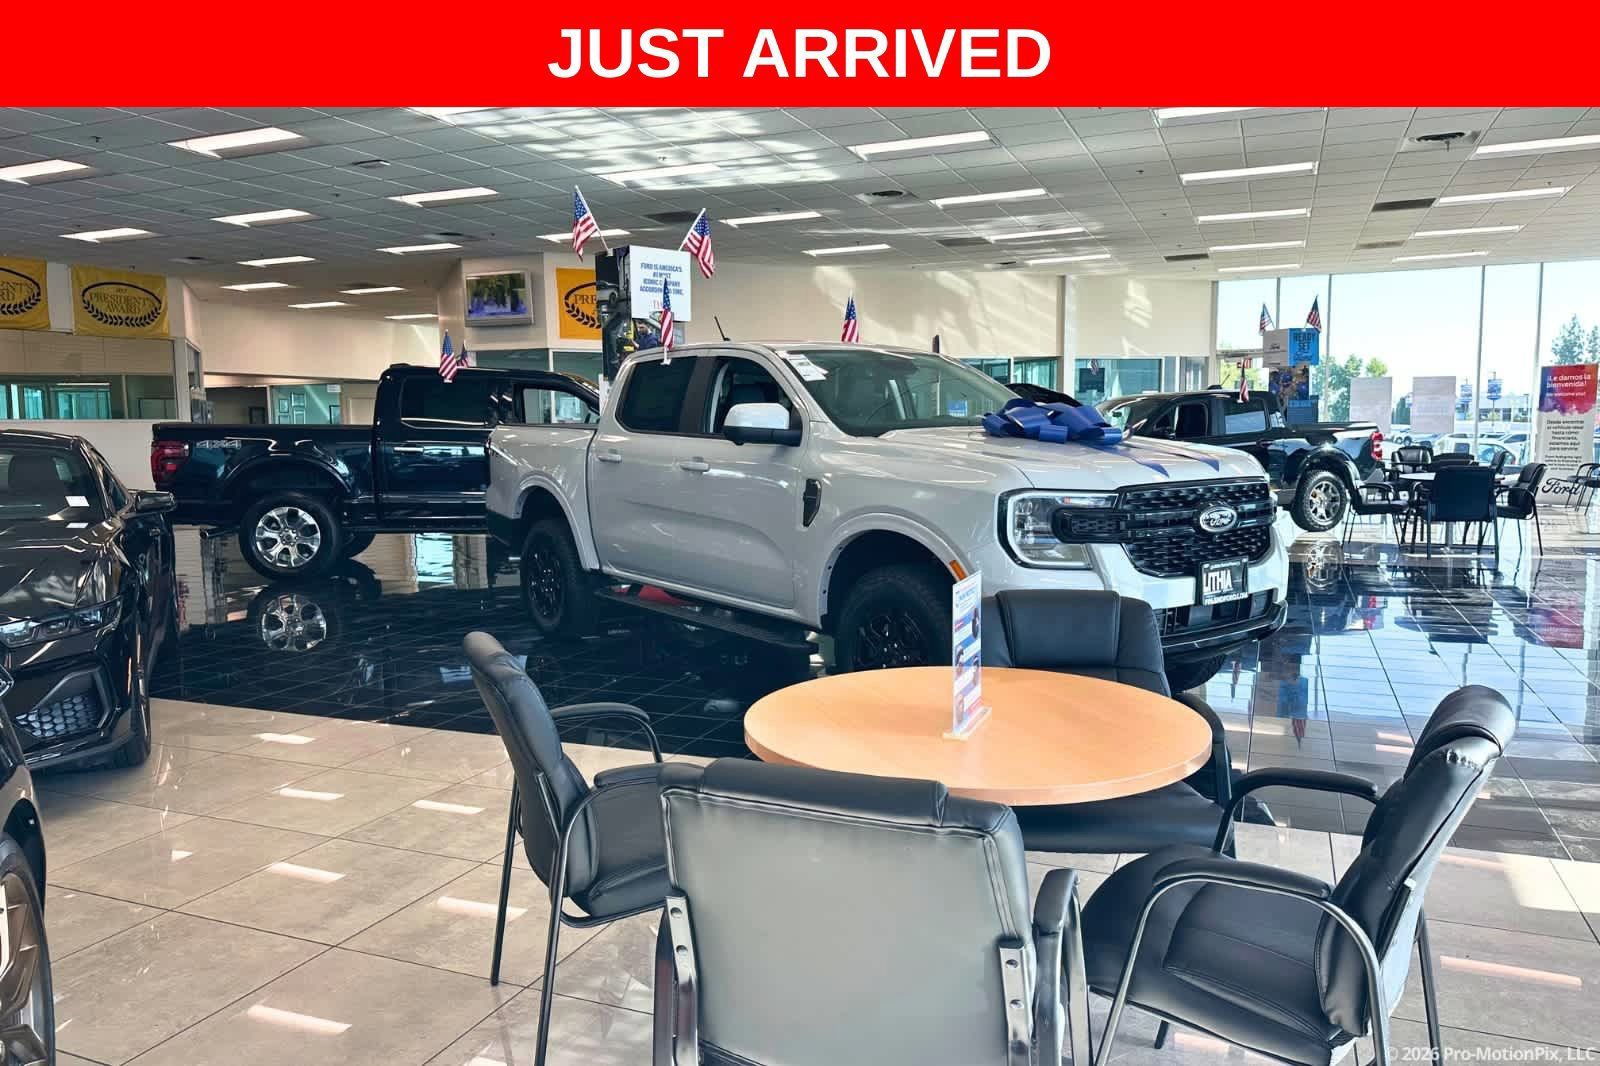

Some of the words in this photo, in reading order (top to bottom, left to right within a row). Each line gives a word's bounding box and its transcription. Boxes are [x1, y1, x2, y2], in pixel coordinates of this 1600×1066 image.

[640, 262, 653, 270] FORD
[1541, 478, 1581, 496] Ford
[1203, 570, 1234, 592] LITHIA
